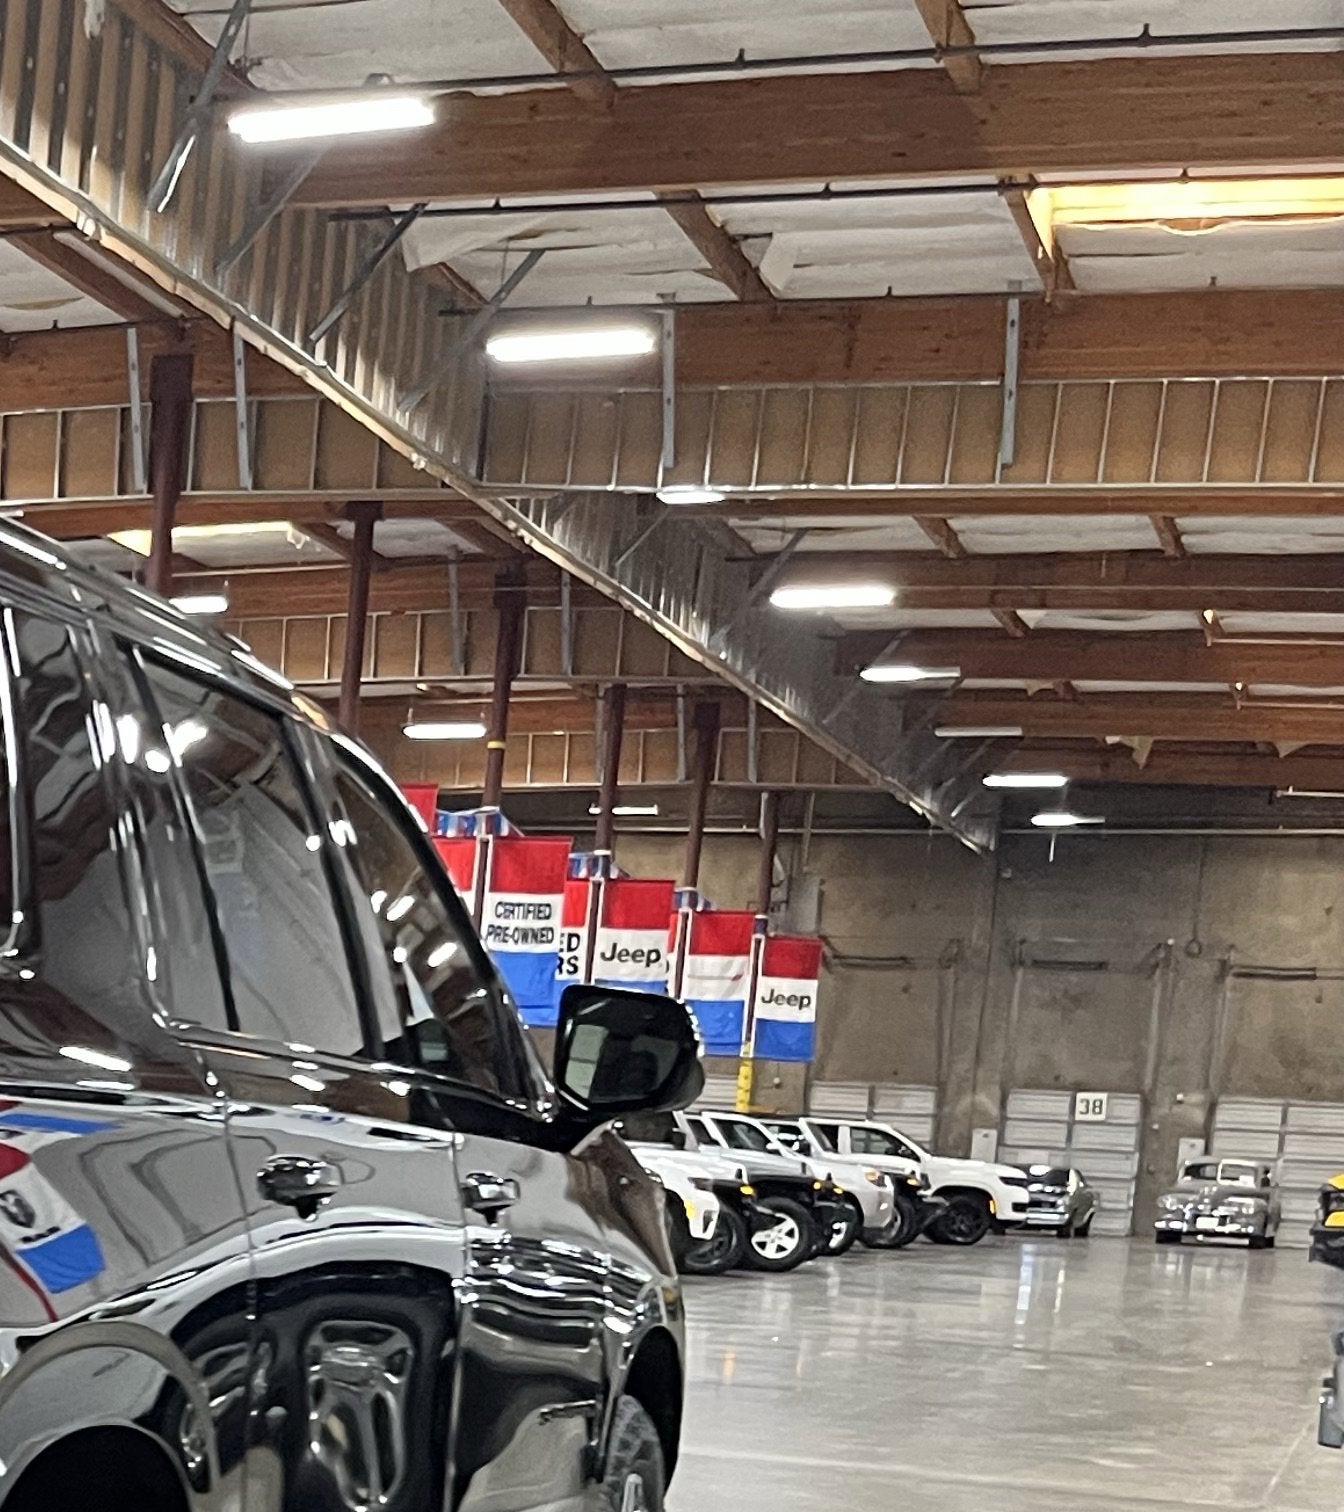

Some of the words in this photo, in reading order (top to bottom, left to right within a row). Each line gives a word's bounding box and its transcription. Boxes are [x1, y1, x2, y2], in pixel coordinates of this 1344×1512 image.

[495, 901, 552, 920] CERTIFIED
[486, 924, 554, 945] PRE-OWNED
[600, 942, 661, 967] Jeep
[761, 988, 812, 1010] Jeep
[1079, 1098, 1103, 1115] 38
